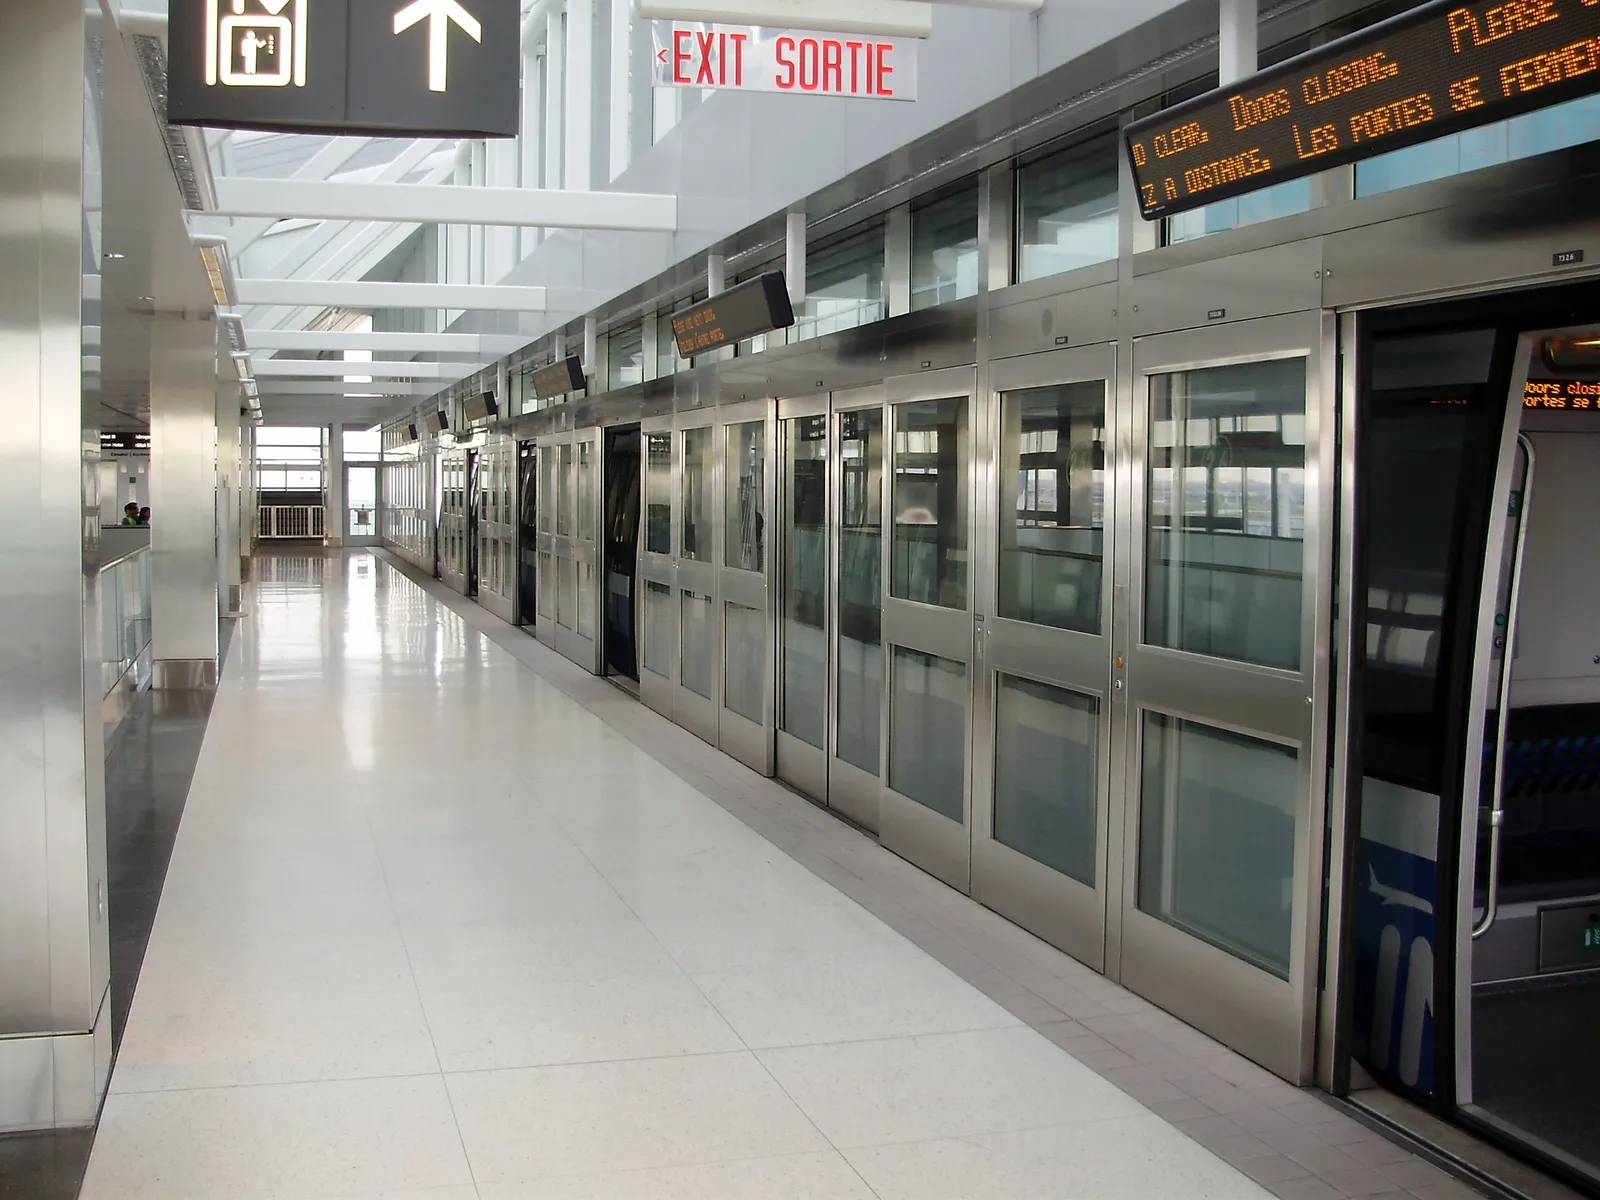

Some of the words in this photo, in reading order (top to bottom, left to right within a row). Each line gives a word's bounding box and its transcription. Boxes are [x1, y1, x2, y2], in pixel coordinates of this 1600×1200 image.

[673, 29, 747, 87] EXIT
[775, 36, 894, 96] SORTIE
[1349, 92, 1435, 143] PORTES
[1448, 75, 1486, 112] SE
[1522, 394, 1567, 407] ortes
[1572, 397, 1590, 408] se
